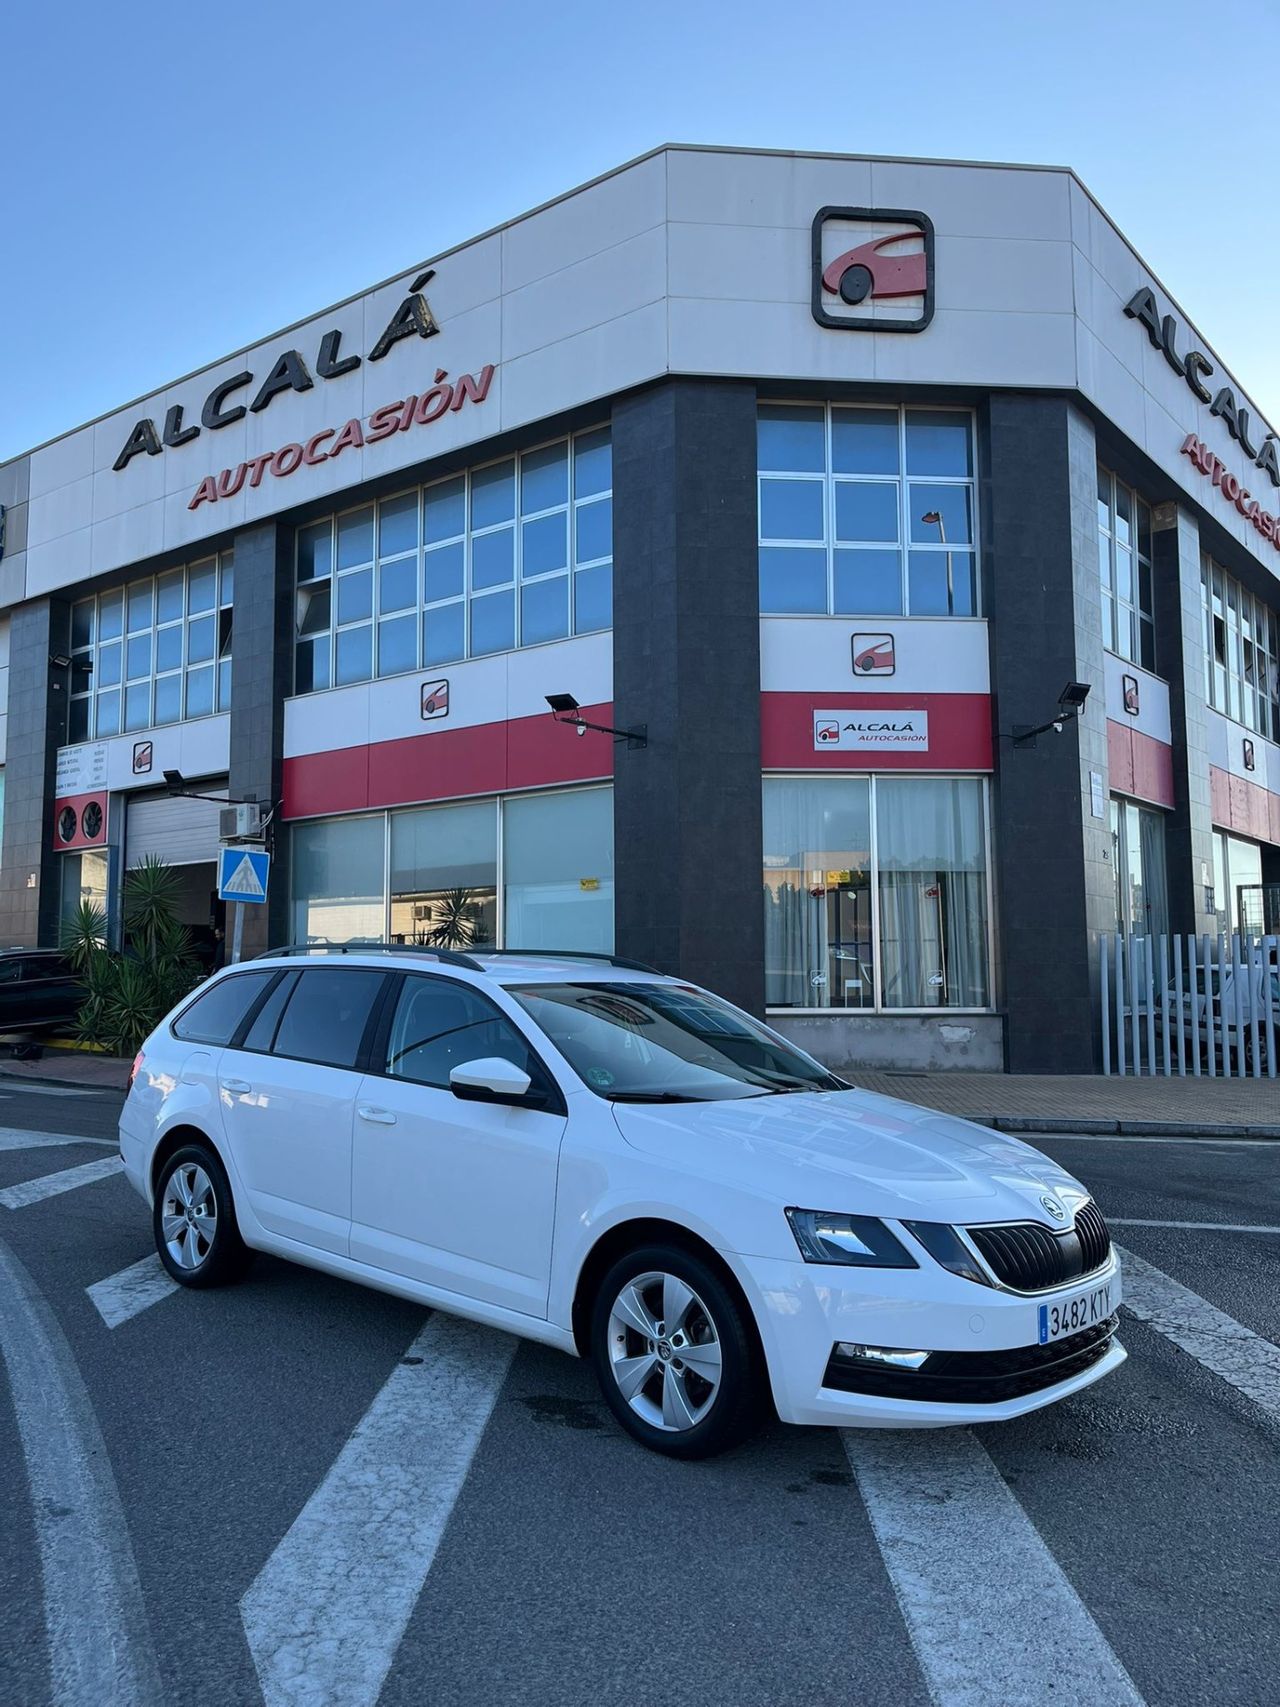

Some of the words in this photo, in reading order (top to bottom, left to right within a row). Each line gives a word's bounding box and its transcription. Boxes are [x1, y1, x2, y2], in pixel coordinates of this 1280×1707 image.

[112, 269, 441, 471] ALCALÁ
[1123, 286, 1280, 488] ALCALÁ
[187, 364, 496, 511] AUTOCASIÓN
[843, 721, 914, 732] ALCALÁ
[857, 734, 927, 742] AUTOCASIÓN
[1051, 1297, 1087, 1336] 3482
[1090, 1285, 1111, 1322] KTY
